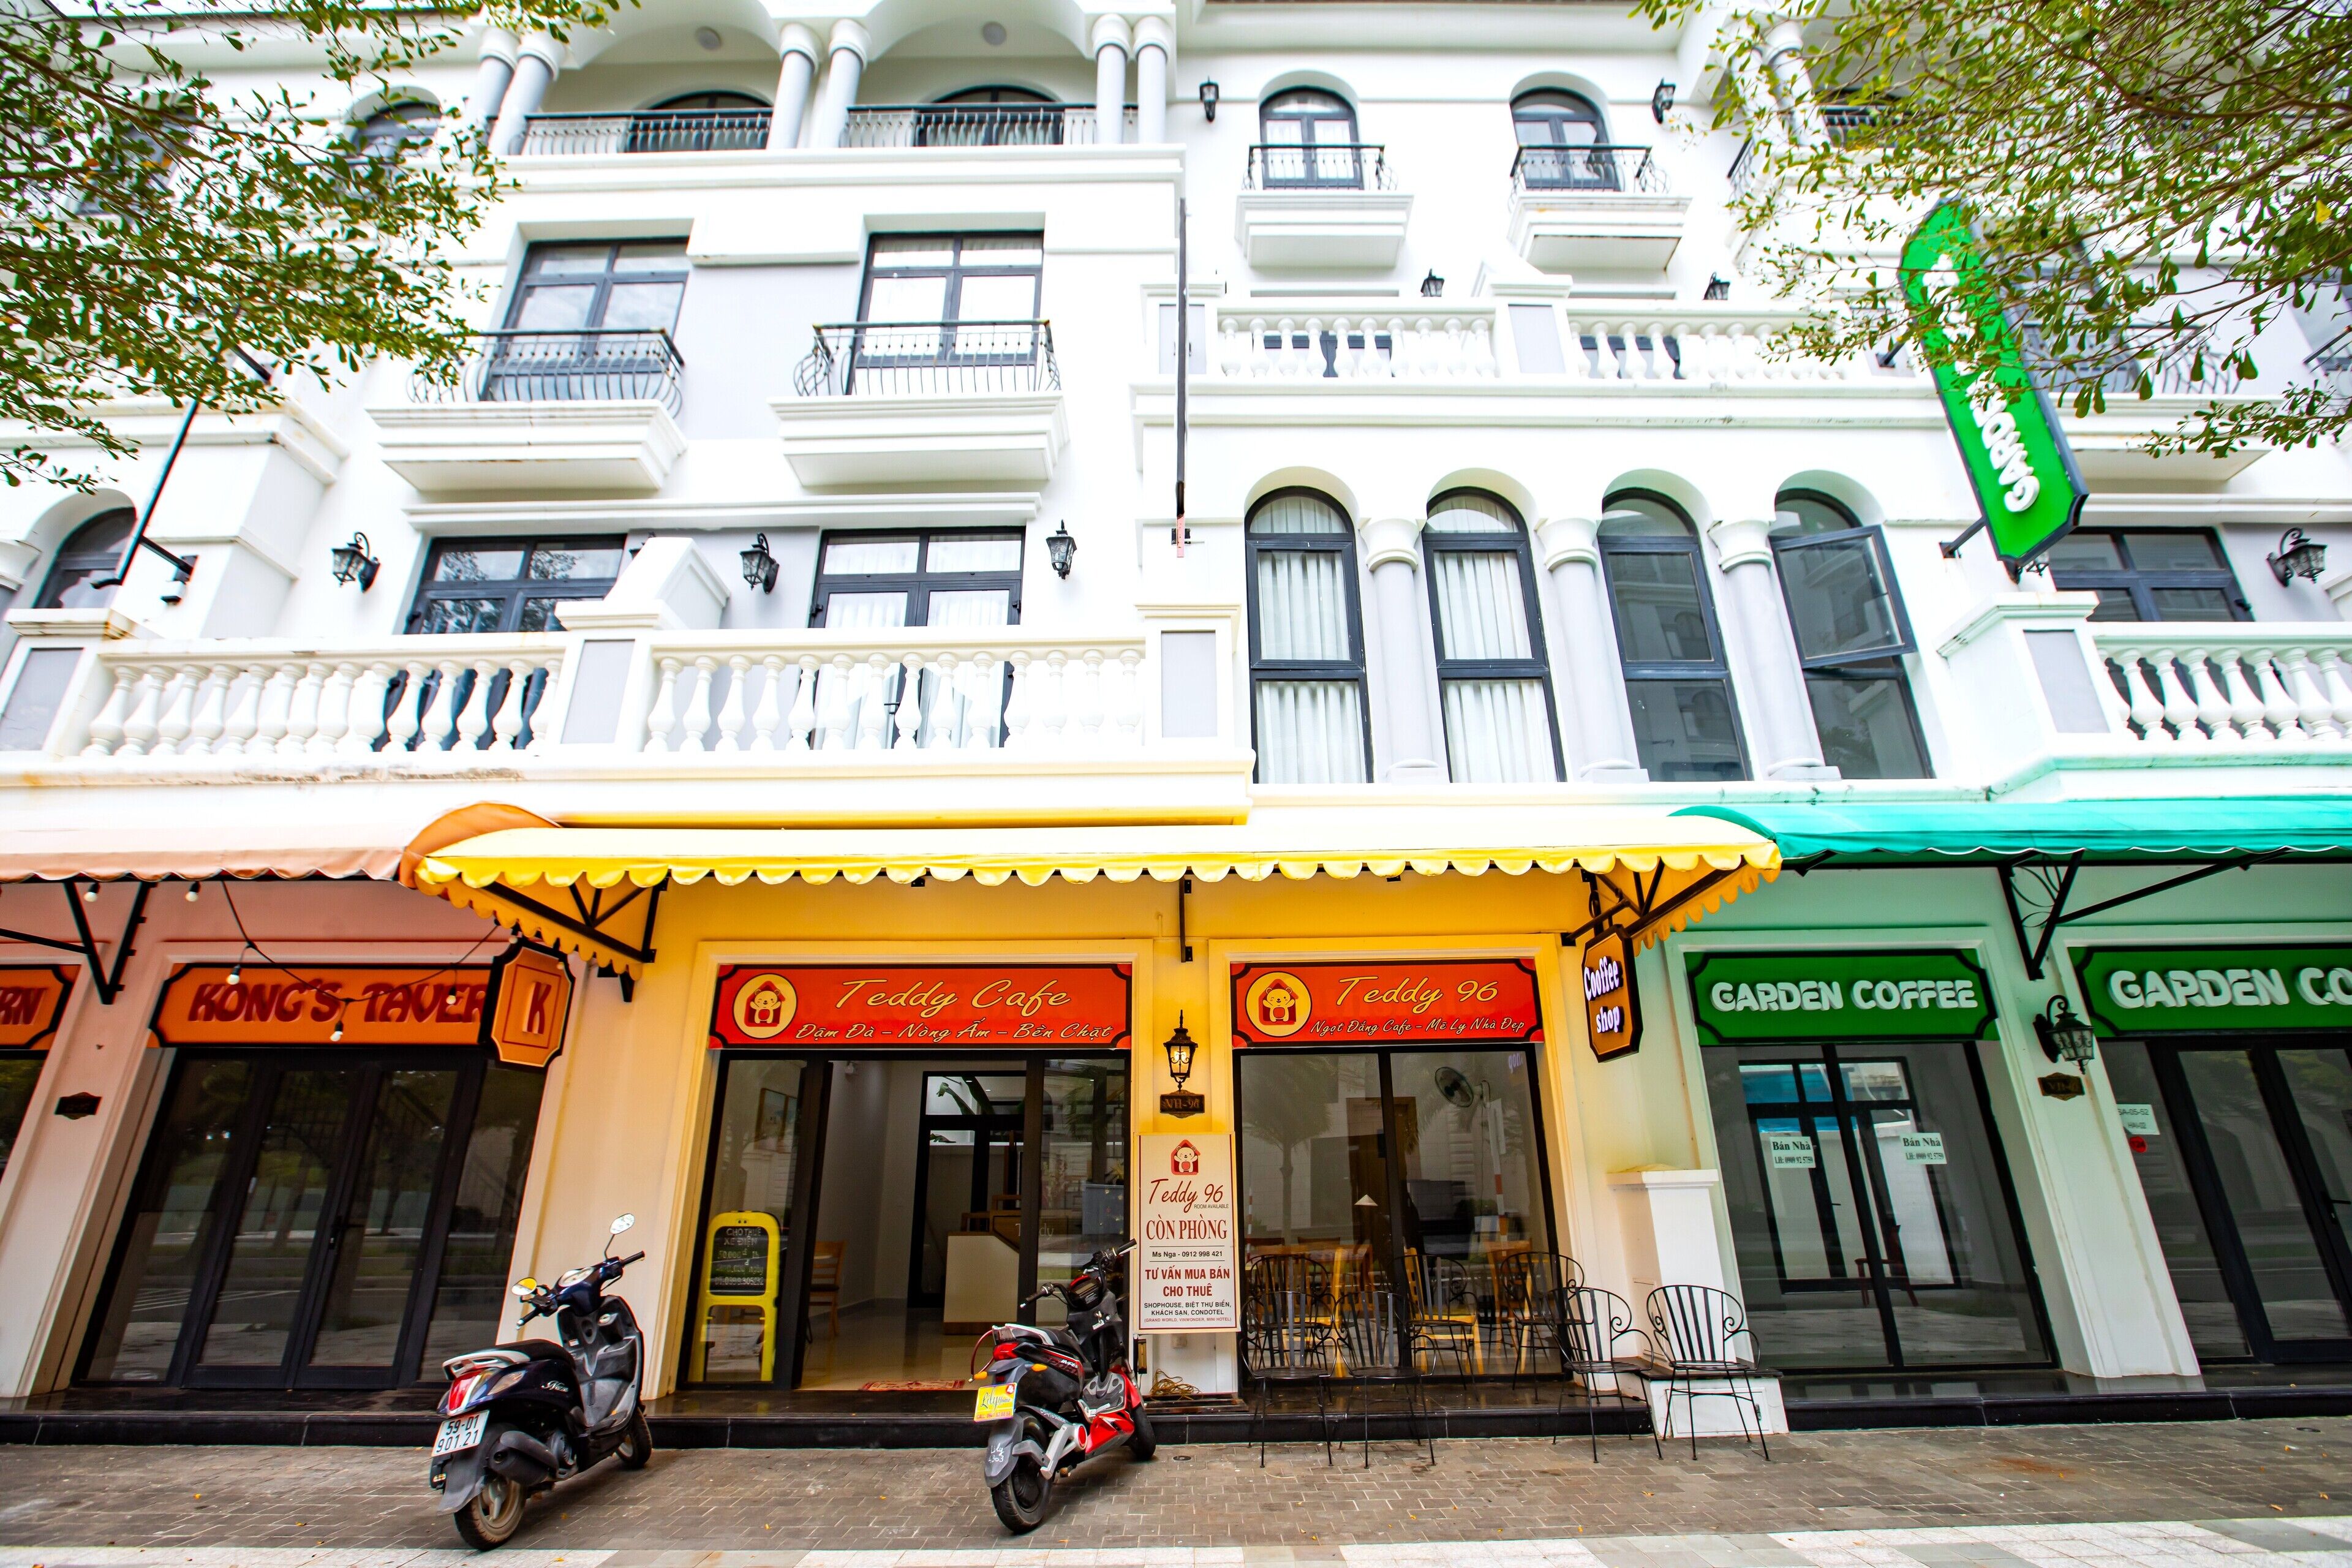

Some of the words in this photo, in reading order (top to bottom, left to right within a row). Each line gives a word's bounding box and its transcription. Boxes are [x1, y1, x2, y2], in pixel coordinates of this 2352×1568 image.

[1584, 956, 1619, 1001] Cooffee
[2108, 969, 2290, 1009] GARDEN
[0, 986, 48, 1025] RN
[187, 978, 343, 1022] KONG'S
[522, 981, 552, 1035] K
[835, 979, 959, 1019] Teddy
[971, 979, 1071, 1017] Cafe
[1336, 976, 1444, 1014] Teddy
[1457, 980, 1499, 1002] 96
[1710, 981, 1844, 1011] GARDEN
[1851, 979, 1978, 1010] COFFEE
[845, 1023, 876, 1038] Đà
[956, 1017, 991, 1038] Ấm
[1012, 1023, 1054, 1038] Bền
[1310, 1020, 1344, 1036] Ngọt
[1382, 1019, 1412, 1035] Cafe
[1449, 1018, 1467, 1035] Ly
[1470, 1017, 1496, 1030] Nhà
[1500, 1017, 1525, 1033] Đẹp
[1596, 1006, 1621, 1033] shop
[1772, 1141, 1790, 1151] Bán
[1792, 1140, 1812, 1151] Nhà
[1903, 1137, 1922, 1147] Bán
[1923, 1137, 1942, 1147] Nhà
[1149, 1178, 1198, 1213] Teddy
[1204, 1183, 1223, 1203] 96
[1015, 1223, 1054, 1240] Tdy
[1146, 1214, 1175, 1240] CÒN
[1179, 1214, 1227, 1240] PHÒNG
[1145, 1267, 1159, 1280] TƯ
[1161, 1265, 1182, 1280] VẤN
[1185, 1268, 1207, 1280] MUA
[1210, 1265, 1230, 1279] BÁN
[1163, 1286, 1183, 1297] CHO
[1186, 1283, 1213, 1296] THUÊ
[435, 1429, 479, 1453] 901.21
